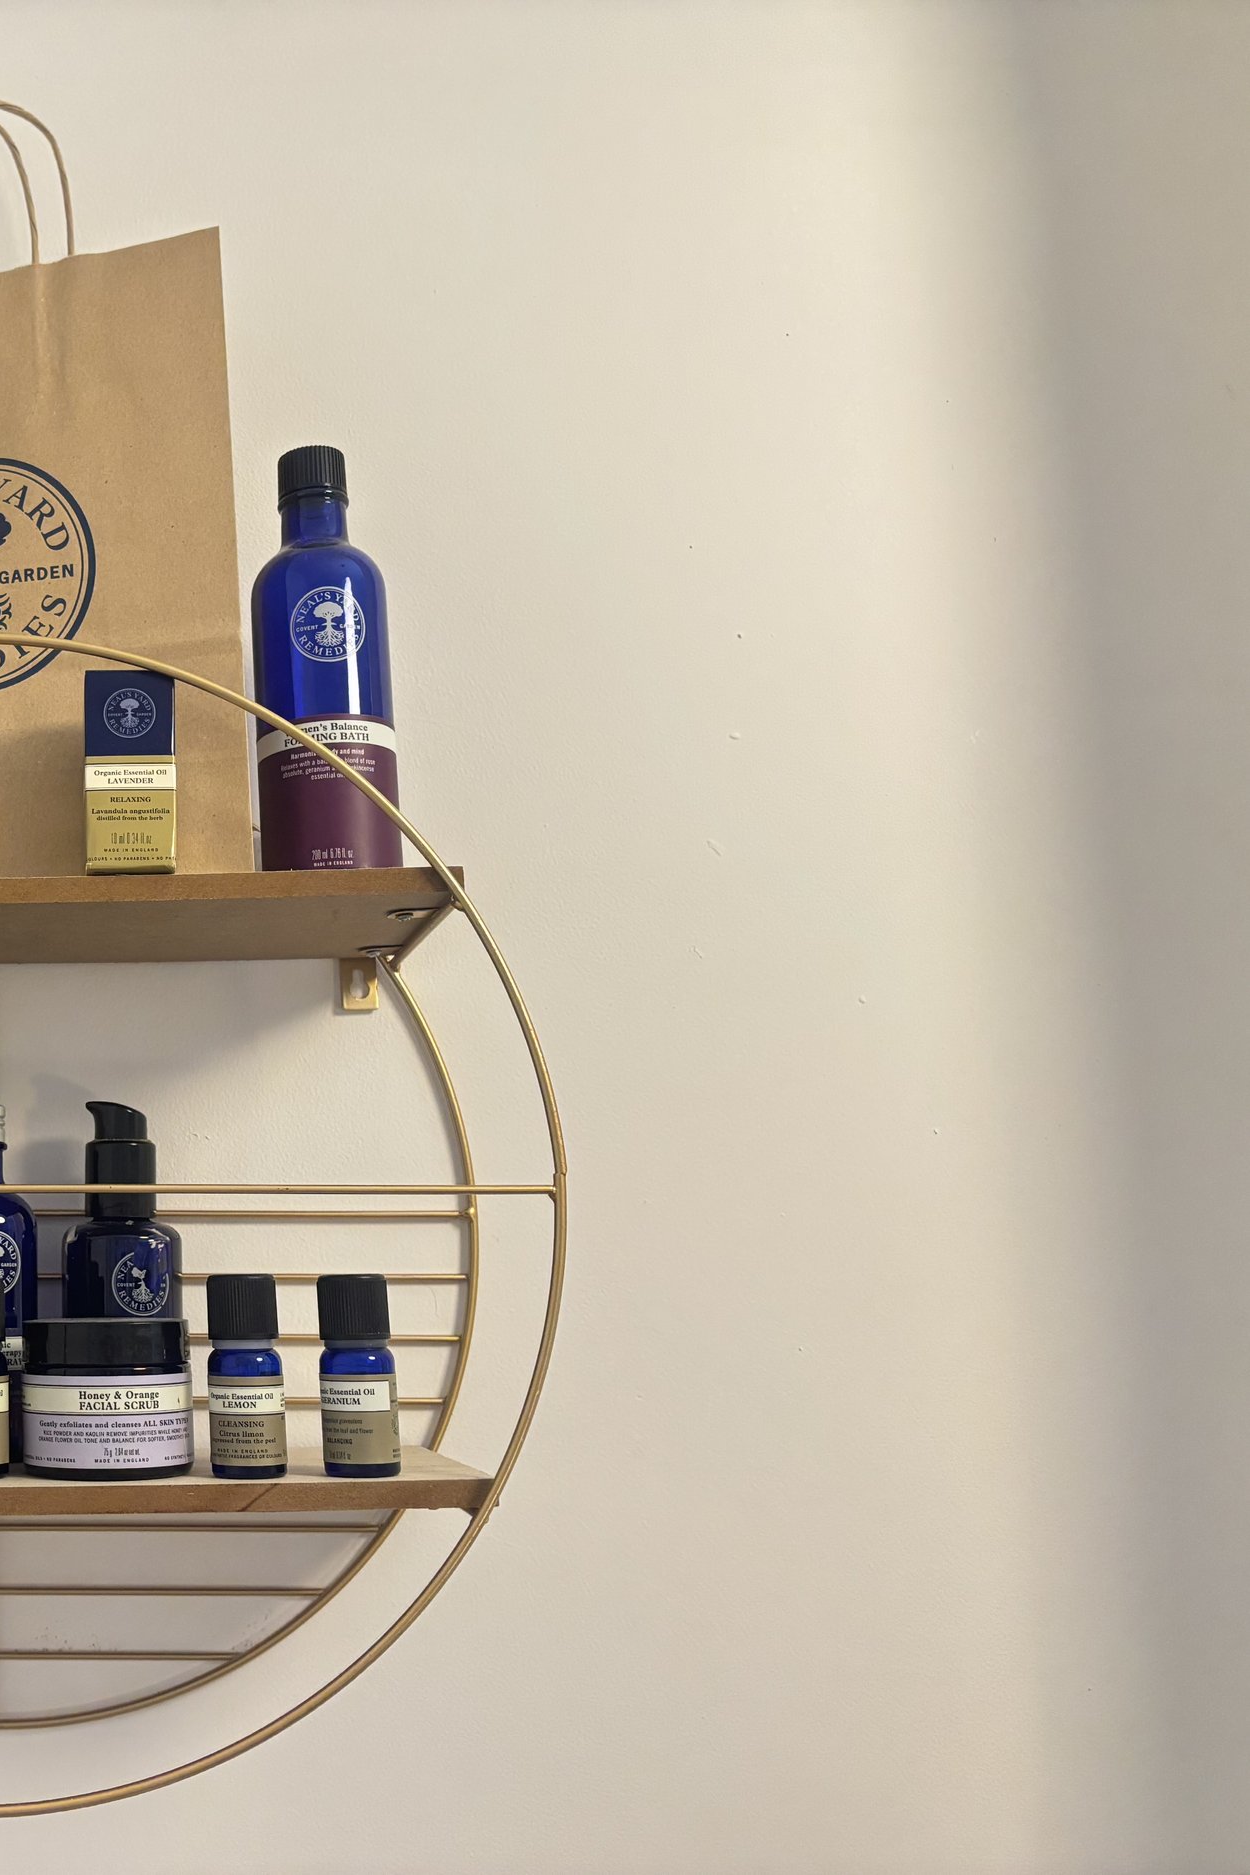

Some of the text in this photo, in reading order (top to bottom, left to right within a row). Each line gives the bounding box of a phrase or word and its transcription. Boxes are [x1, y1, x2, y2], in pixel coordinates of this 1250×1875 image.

[296, 592, 330, 623] NEAL'S
[296, 624, 318, 632] COVENT
[108, 692, 151, 711] NEAL'S YARD
[109, 718, 150, 734] REMEDIES
[330, 722, 368, 732] Balance
[340, 732, 369, 742] BATH
[305, 766, 330, 775] geranium
[311, 772, 336, 780] essential
[0, 1237, 16, 1260] YARD
[119, 1290, 164, 1311] REMEDIES
[79, 1391, 159, 1401] Honey & Orange
[210, 1392, 230, 1400] Organic
[79, 1401, 159, 1410] FACIAL SCRUB
[39, 1420, 58, 1428] Gently
